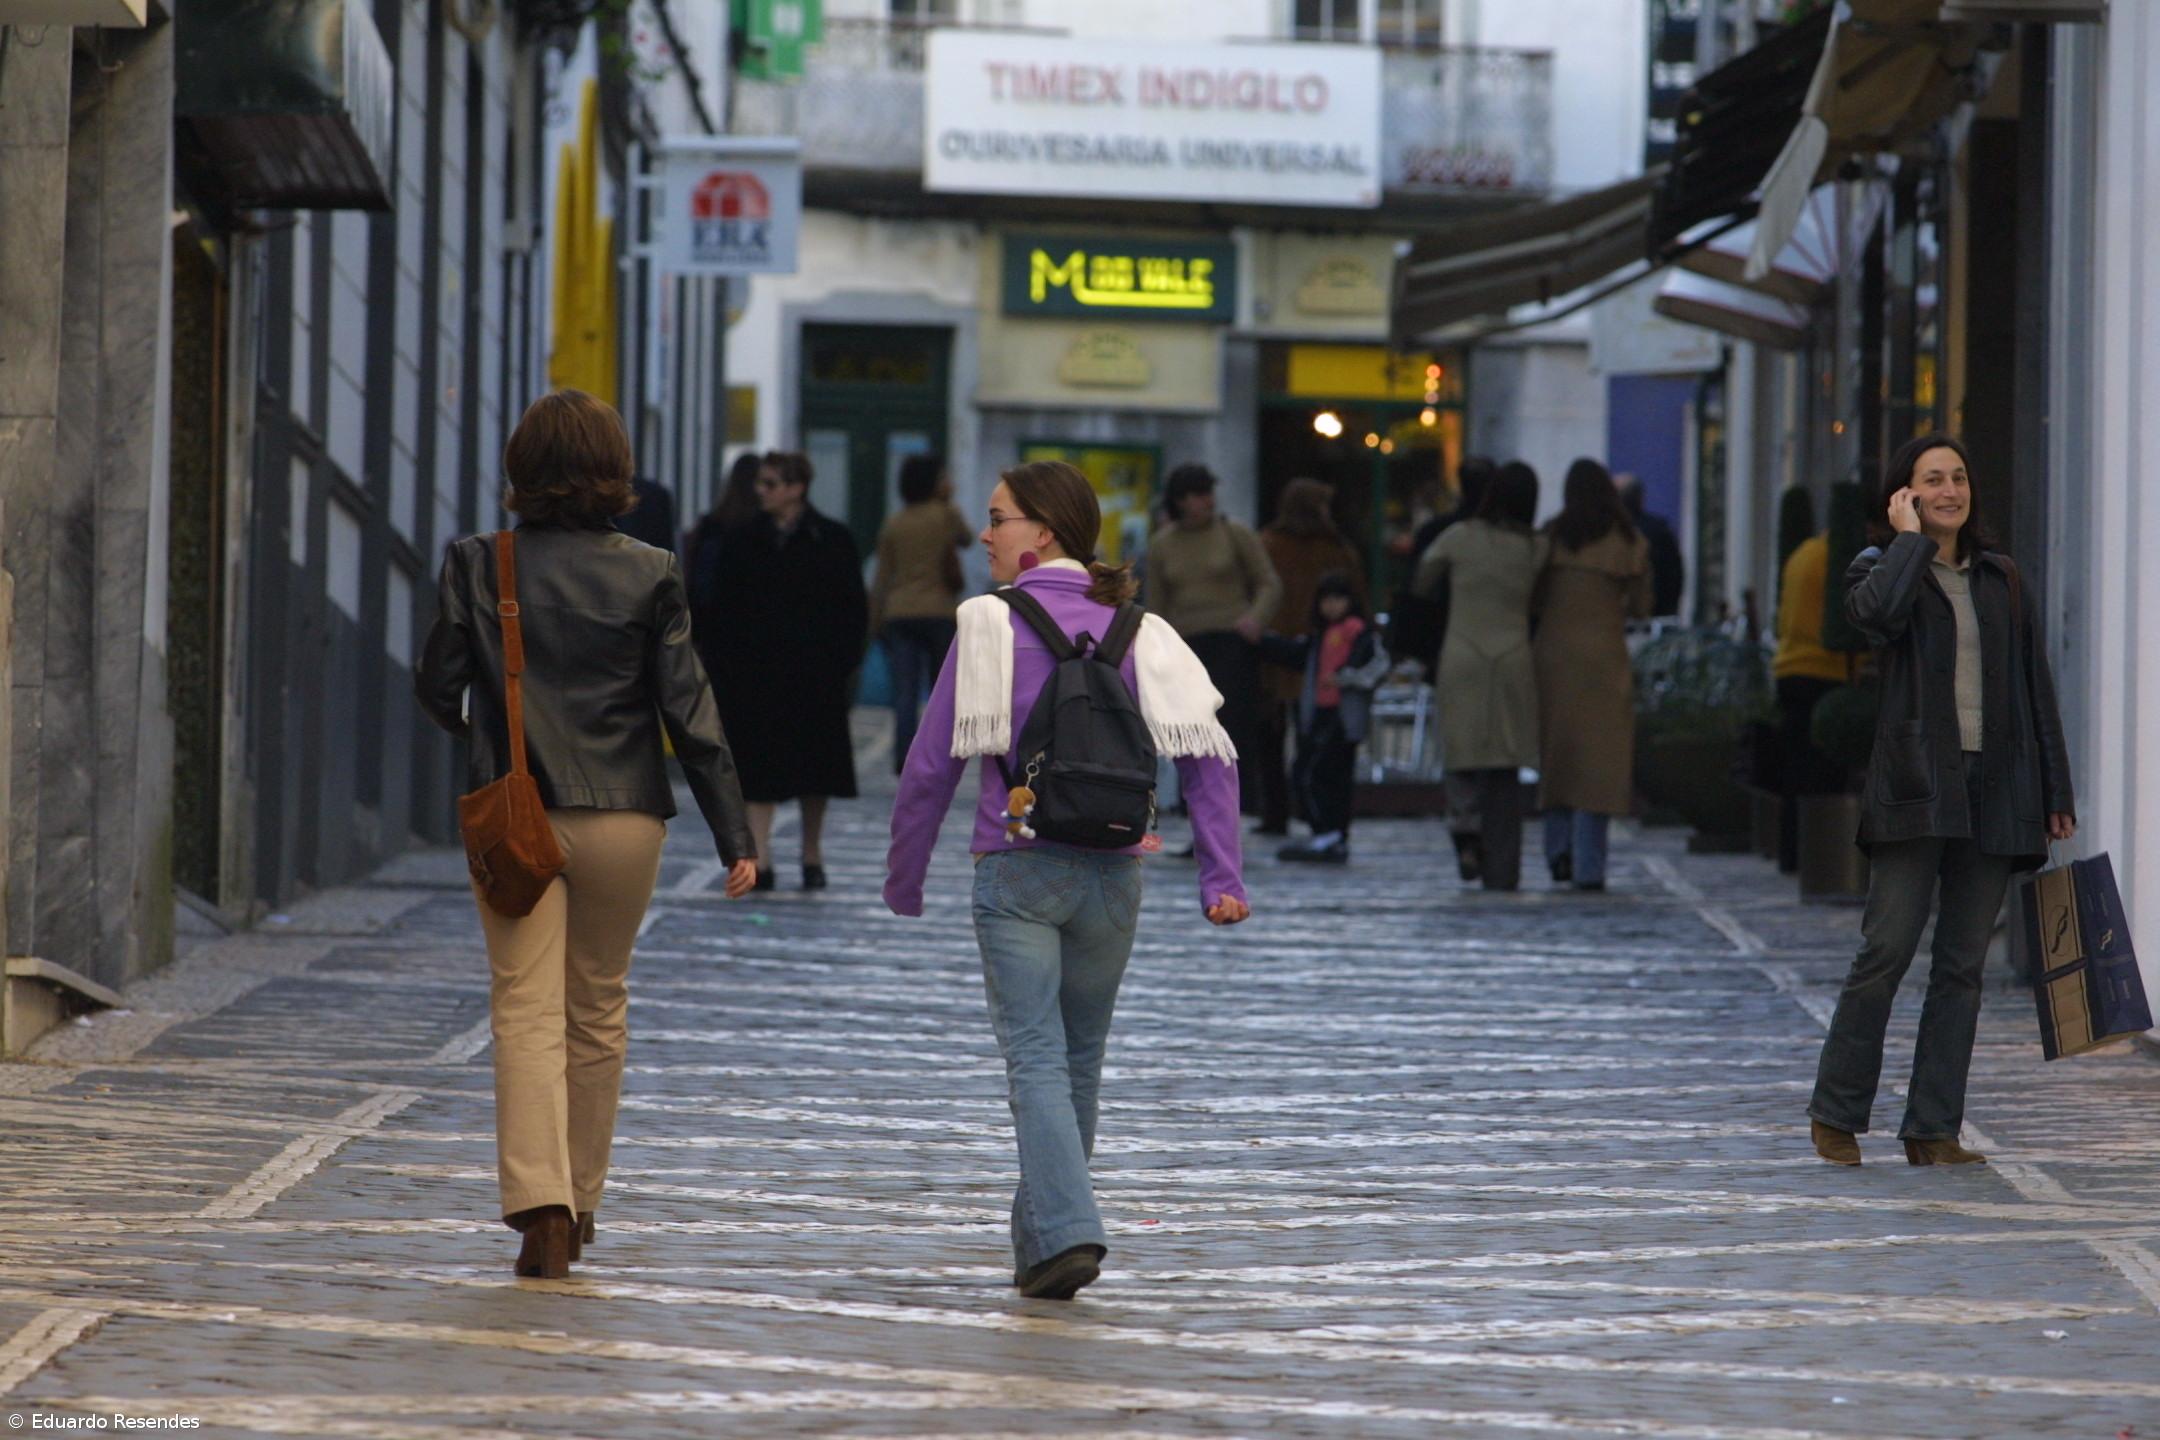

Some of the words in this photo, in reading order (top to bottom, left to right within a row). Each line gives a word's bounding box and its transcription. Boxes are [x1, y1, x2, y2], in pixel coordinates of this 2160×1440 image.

[982, 61, 1125, 106] TIMEX
[1136, 66, 1330, 115] INDIGLO
[1179, 137, 1368, 178] UNIVERSAL
